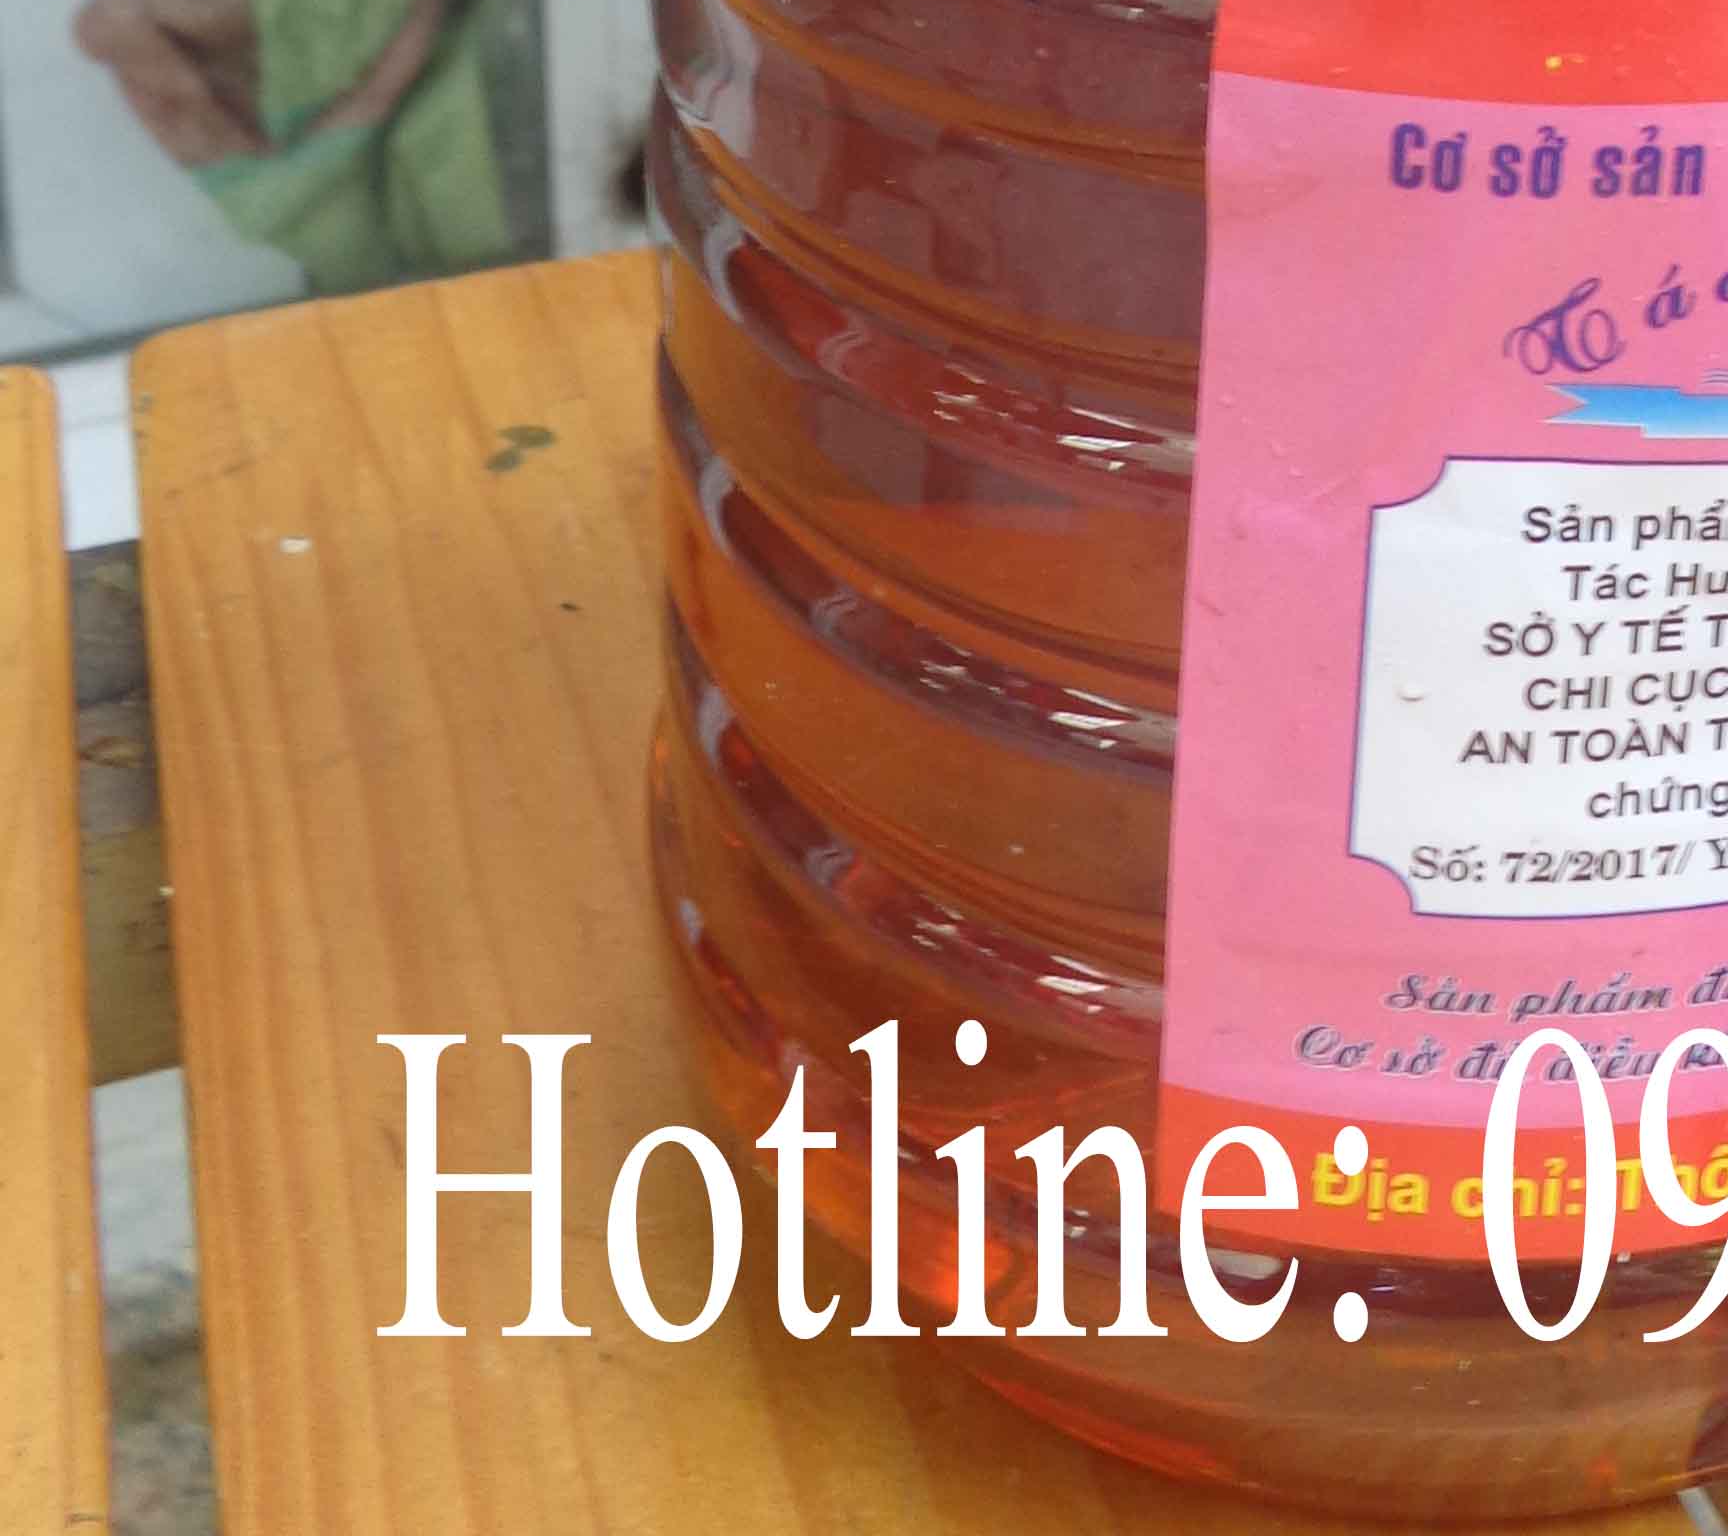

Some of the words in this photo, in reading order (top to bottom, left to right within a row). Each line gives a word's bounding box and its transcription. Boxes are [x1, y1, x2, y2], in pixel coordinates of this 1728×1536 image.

[1389, 120, 1468, 194] Cơ
[1488, 126, 1565, 200] sở
[1592, 126, 1706, 198] sản
[1522, 505, 1614, 544] Sản
[1562, 562, 1650, 601] Tác
[1483, 611, 1556, 658] SỞ
[1571, 621, 1606, 657] Y
[1621, 603, 1687, 655] TẾ
[1524, 675, 1611, 712] CHI
[1458, 729, 1533, 765] AN
[1550, 718, 1690, 764] TOÀN
[1409, 844, 1487, 883] Số:
[1385, 972, 1497, 1015] Sản
[1311, 1150, 1431, 1223] Địa
